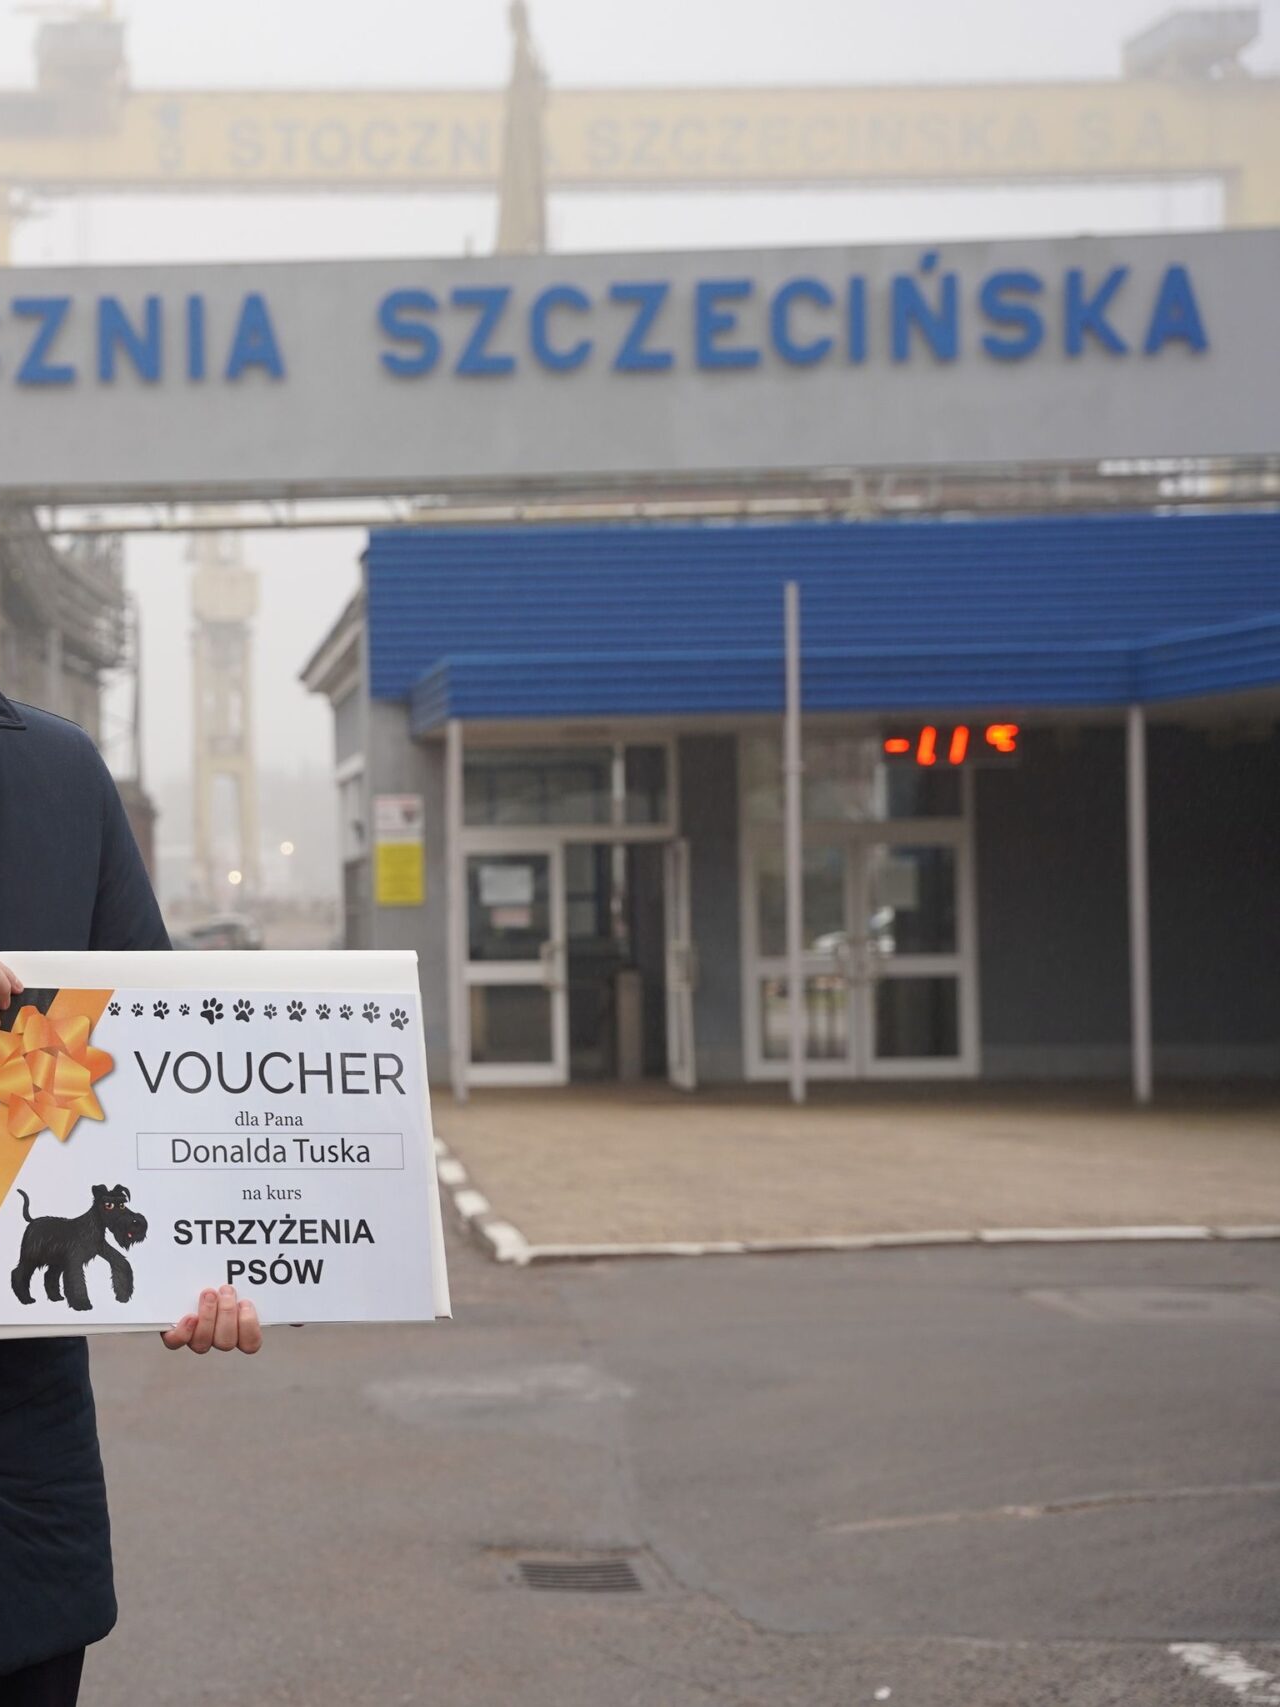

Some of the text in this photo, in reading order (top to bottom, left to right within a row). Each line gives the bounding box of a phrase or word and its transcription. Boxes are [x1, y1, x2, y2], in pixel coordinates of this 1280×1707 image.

[377, 253, 1210, 378] SZCZECIŃSKA
[134, 1051, 406, 1095] VOUCHER
[235, 1111, 304, 1126] dla Pana
[171, 1137, 371, 1164] Donalda Tuska
[242, 1185, 302, 1200] na kurs
[173, 1213, 376, 1245] STRZYŻENIA
[226, 1253, 324, 1285] PSÓW
